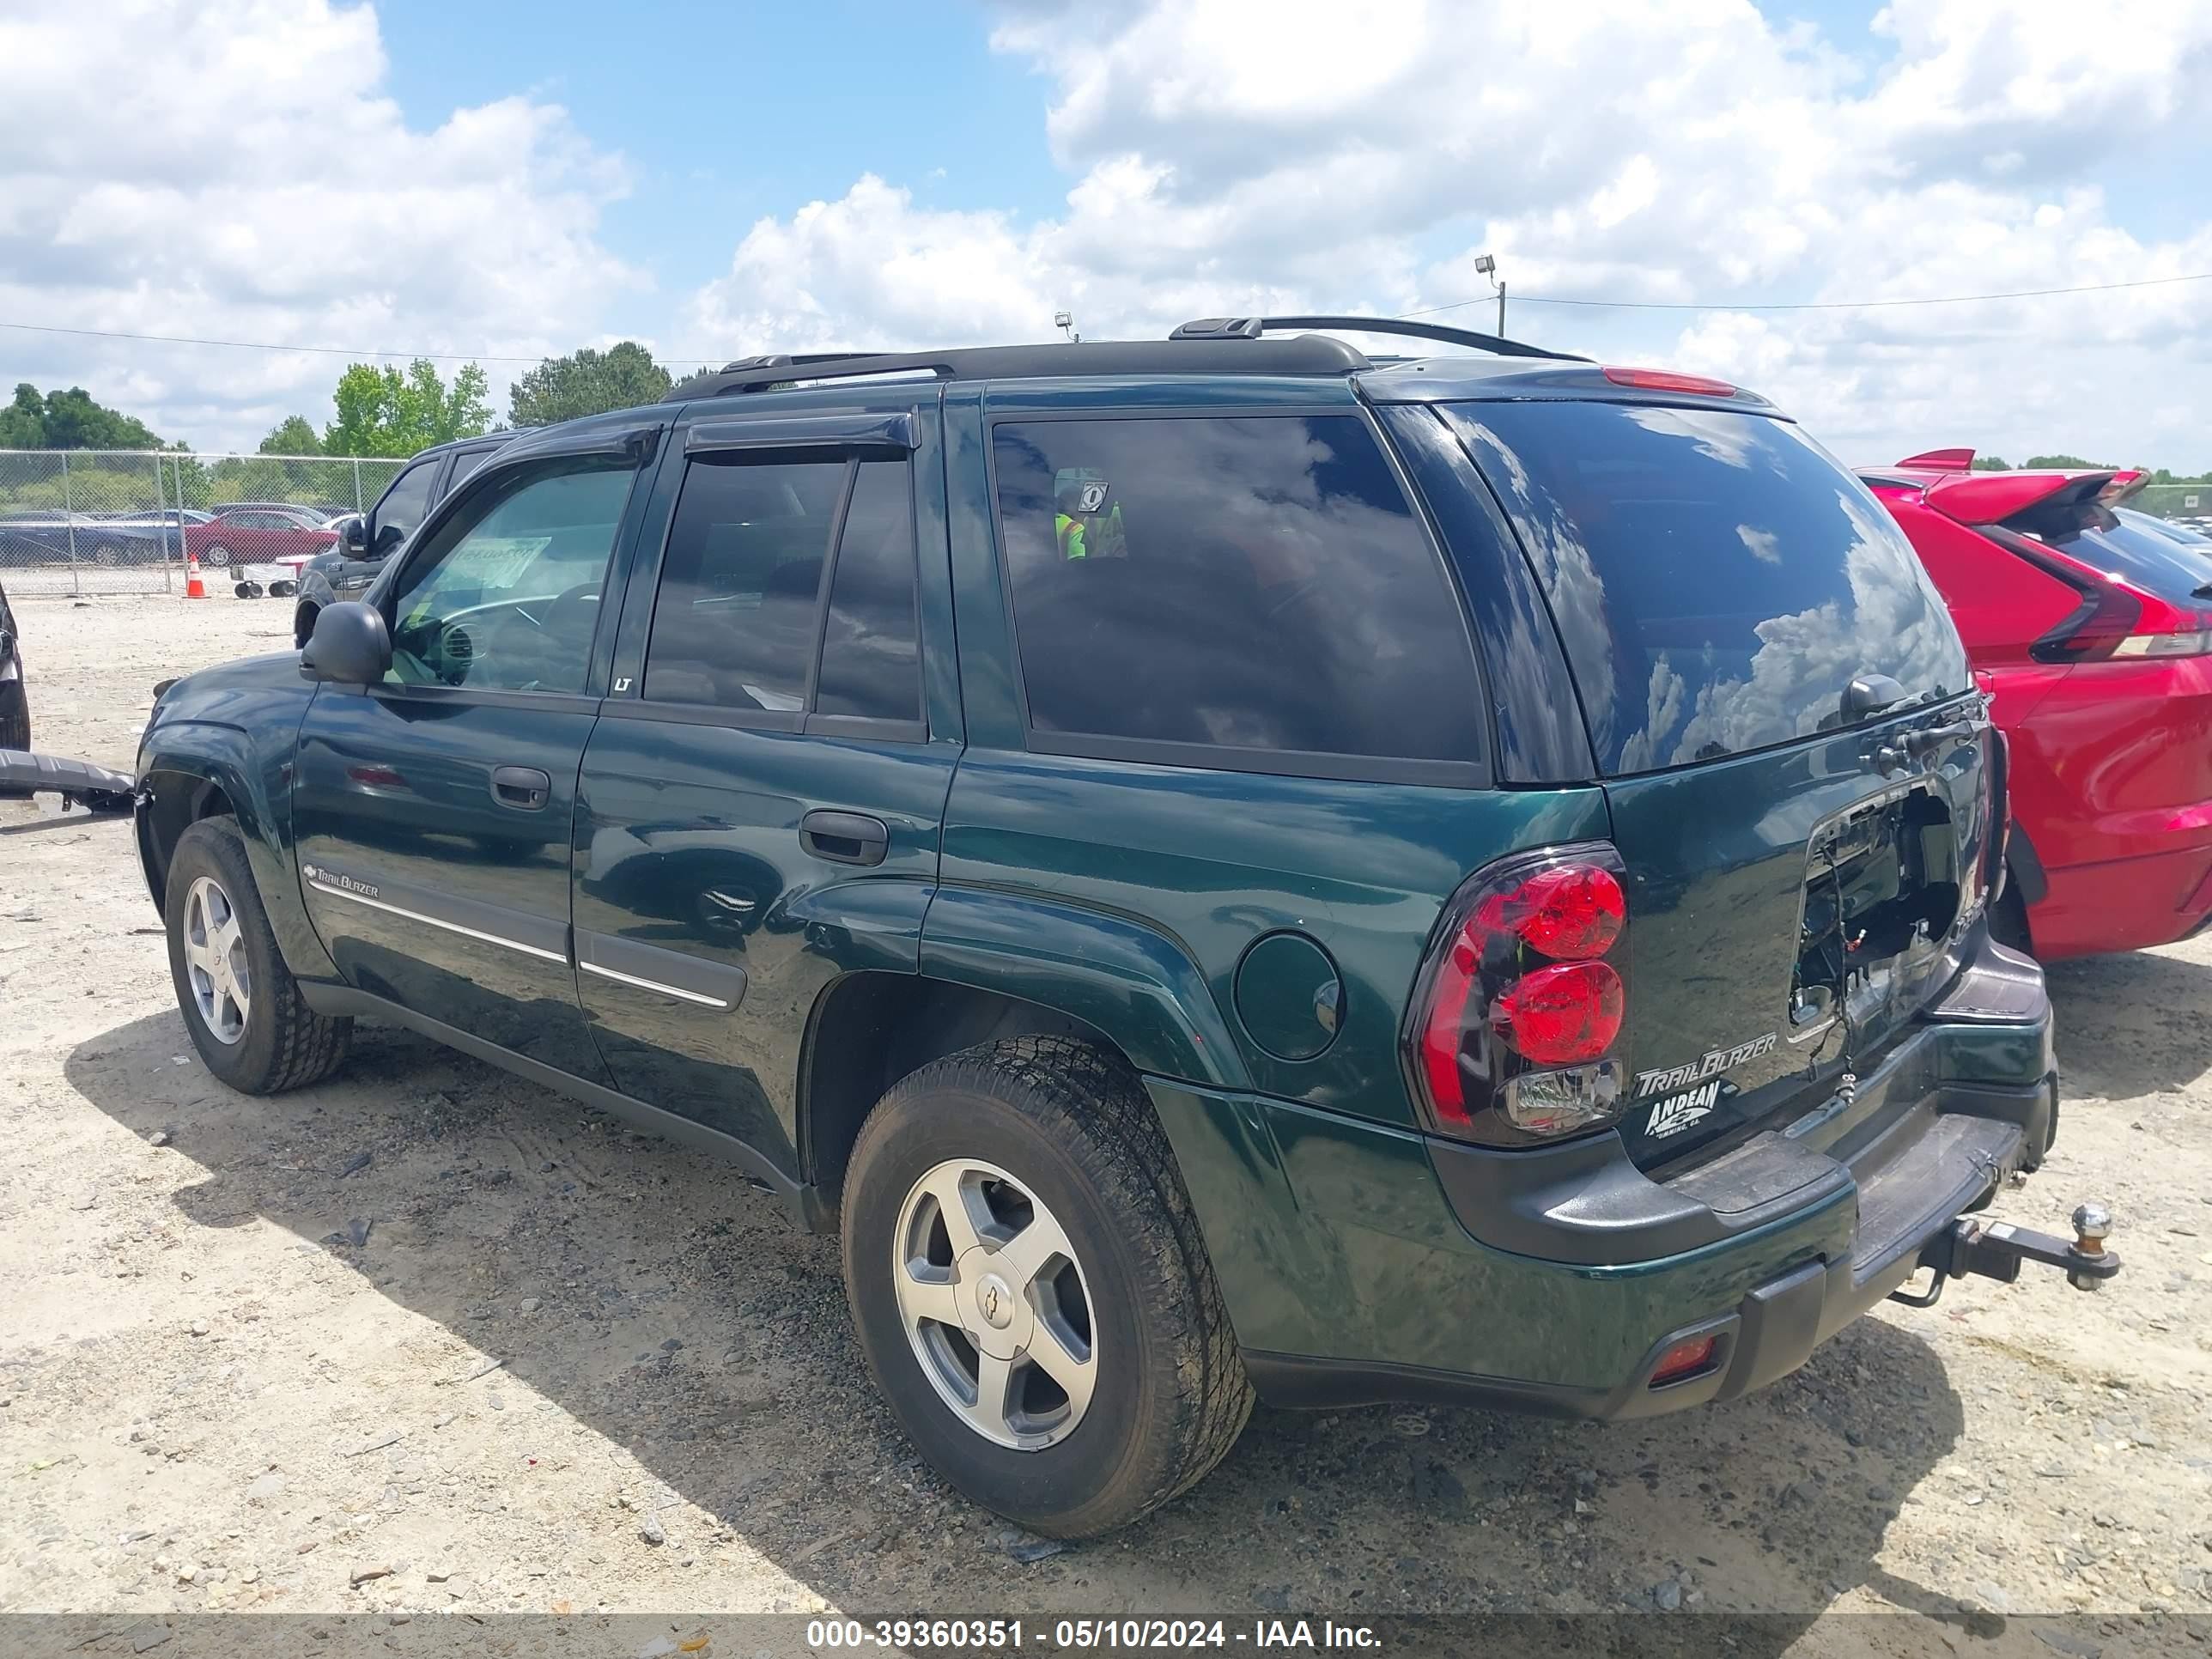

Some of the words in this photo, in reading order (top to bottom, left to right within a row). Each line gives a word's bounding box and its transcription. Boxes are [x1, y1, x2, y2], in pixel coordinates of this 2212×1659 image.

[614, 678, 633, 691] LT
[317, 868, 379, 898] TRAILBLAZER
[1635, 1032, 1778, 1098] TRAILBLAZER
[1644, 1079, 1721, 1136] ANDEAN
